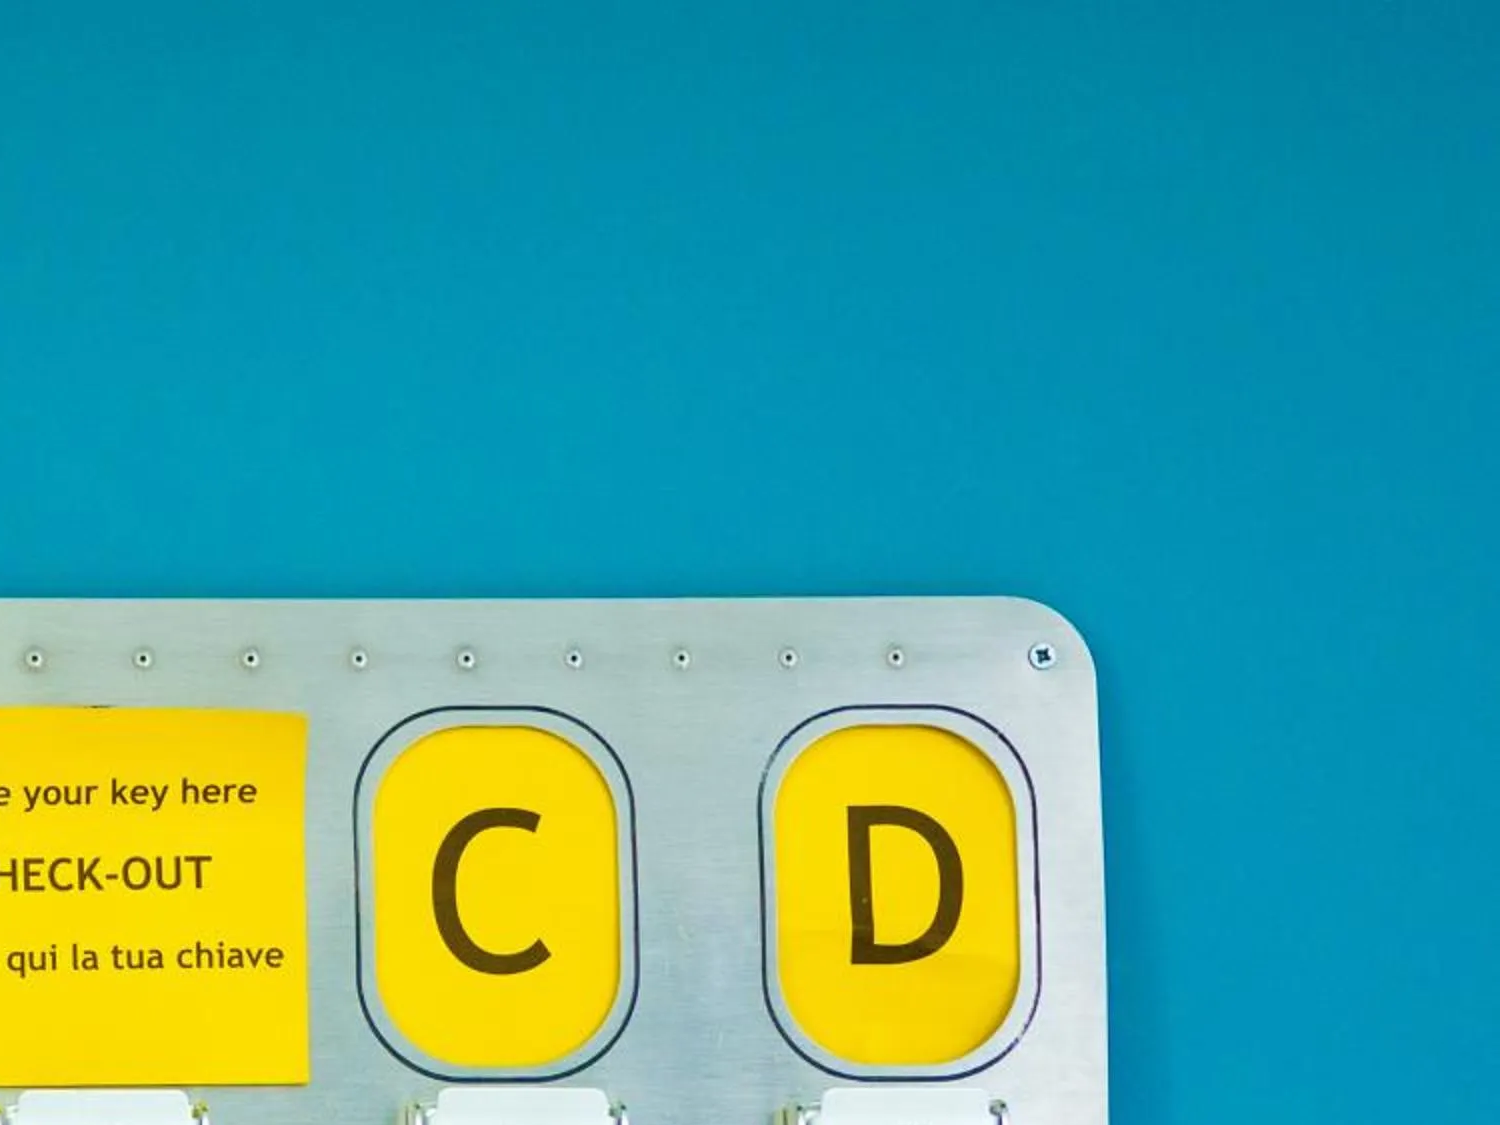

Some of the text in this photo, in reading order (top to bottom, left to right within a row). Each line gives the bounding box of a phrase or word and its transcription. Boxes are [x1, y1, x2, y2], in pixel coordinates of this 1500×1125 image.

[23, 785, 99, 812] your
[111, 778, 169, 811] key
[181, 777, 257, 804] here
[431, 807, 552, 976] C
[846, 805, 964, 965] D
[7, 944, 57, 977] qui
[72, 943, 99, 970] la
[111, 945, 164, 970] tua
[177, 941, 284, 969] chiave
